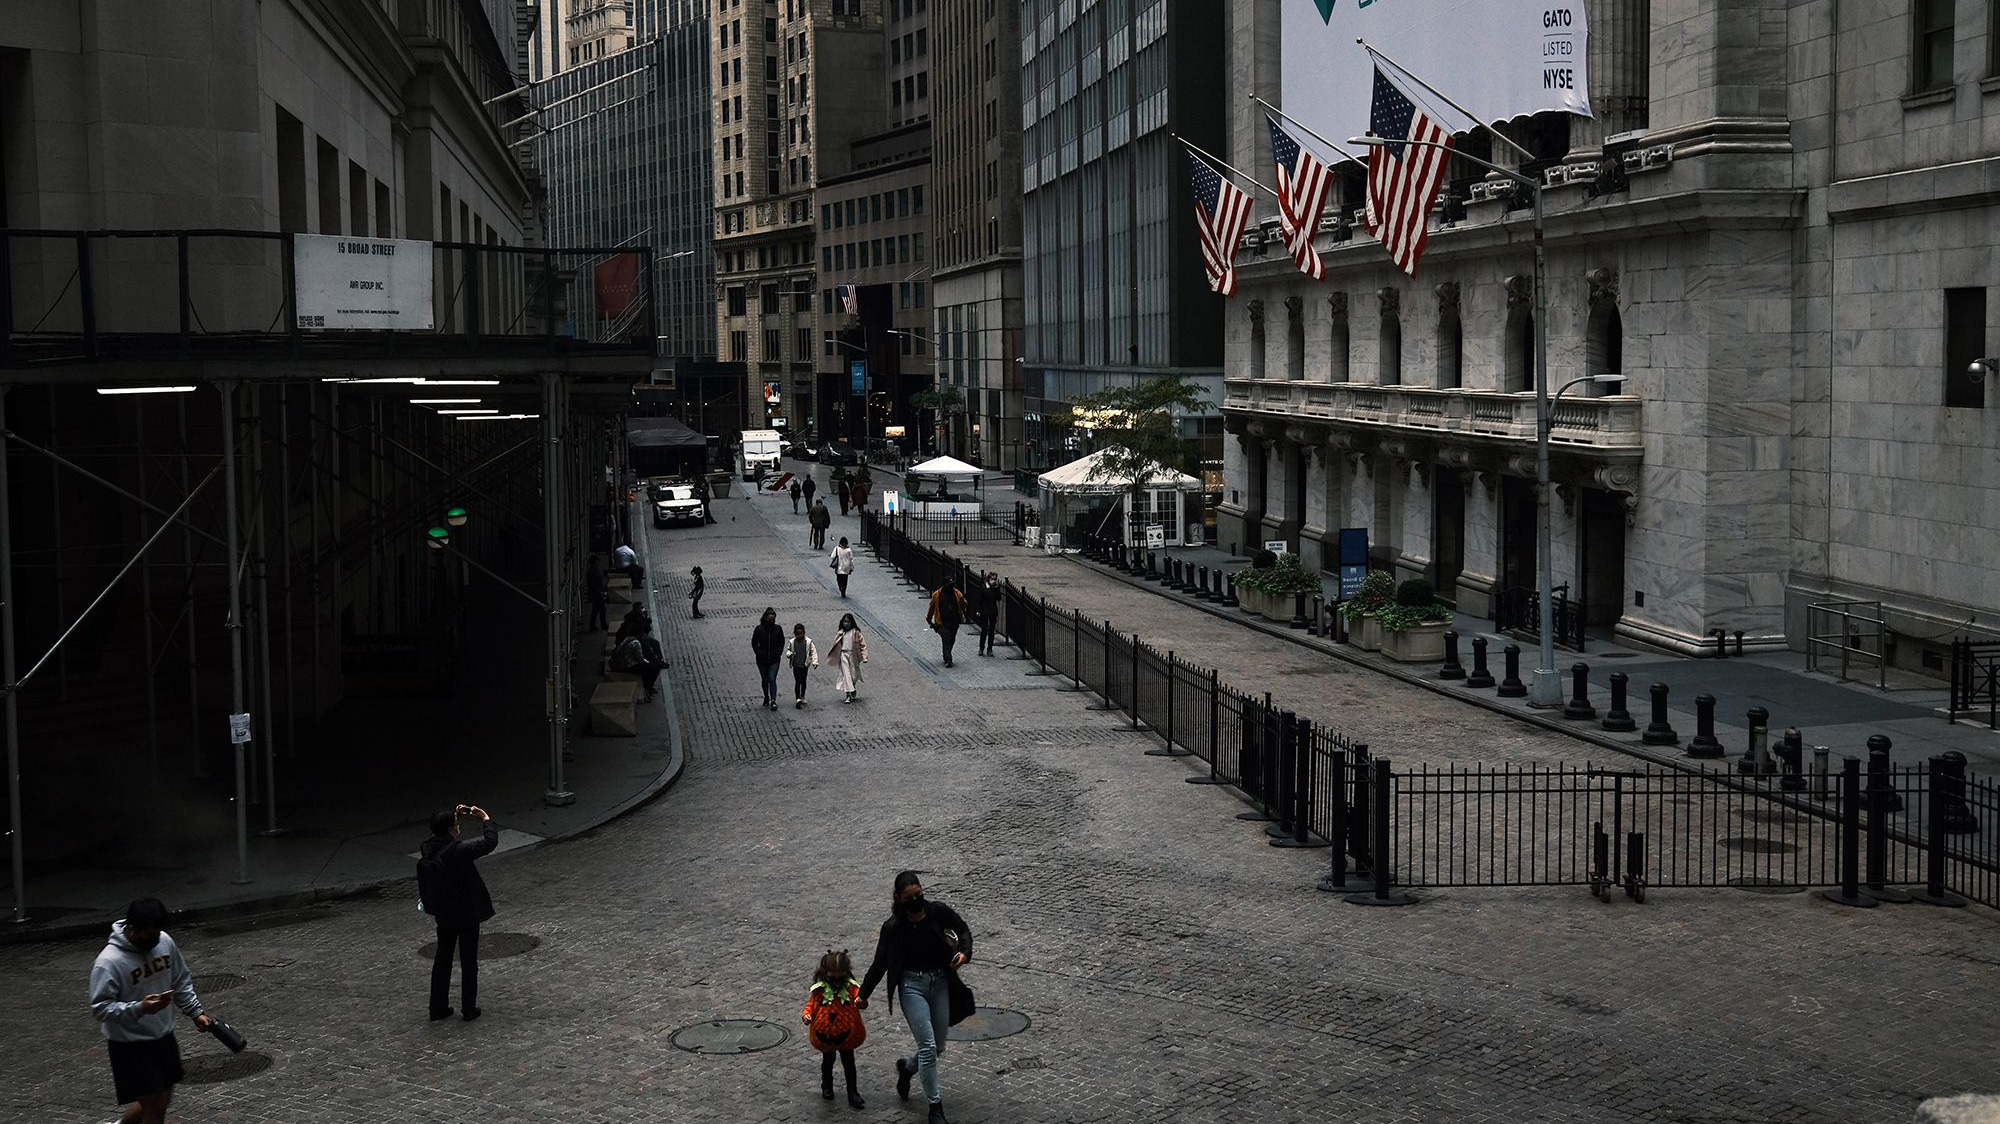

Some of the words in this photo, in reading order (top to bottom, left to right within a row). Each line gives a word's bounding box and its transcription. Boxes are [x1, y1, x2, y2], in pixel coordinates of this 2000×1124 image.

[1543, 9, 1572, 27] GATO
[1543, 41, 1573, 56] LISTED
[1543, 69, 1573, 89] NYSE
[338, 242, 345, 254] 15
[348, 243, 369, 255] BROAD
[371, 244, 395, 256] STREET
[360, 281, 374, 290] GROUP
